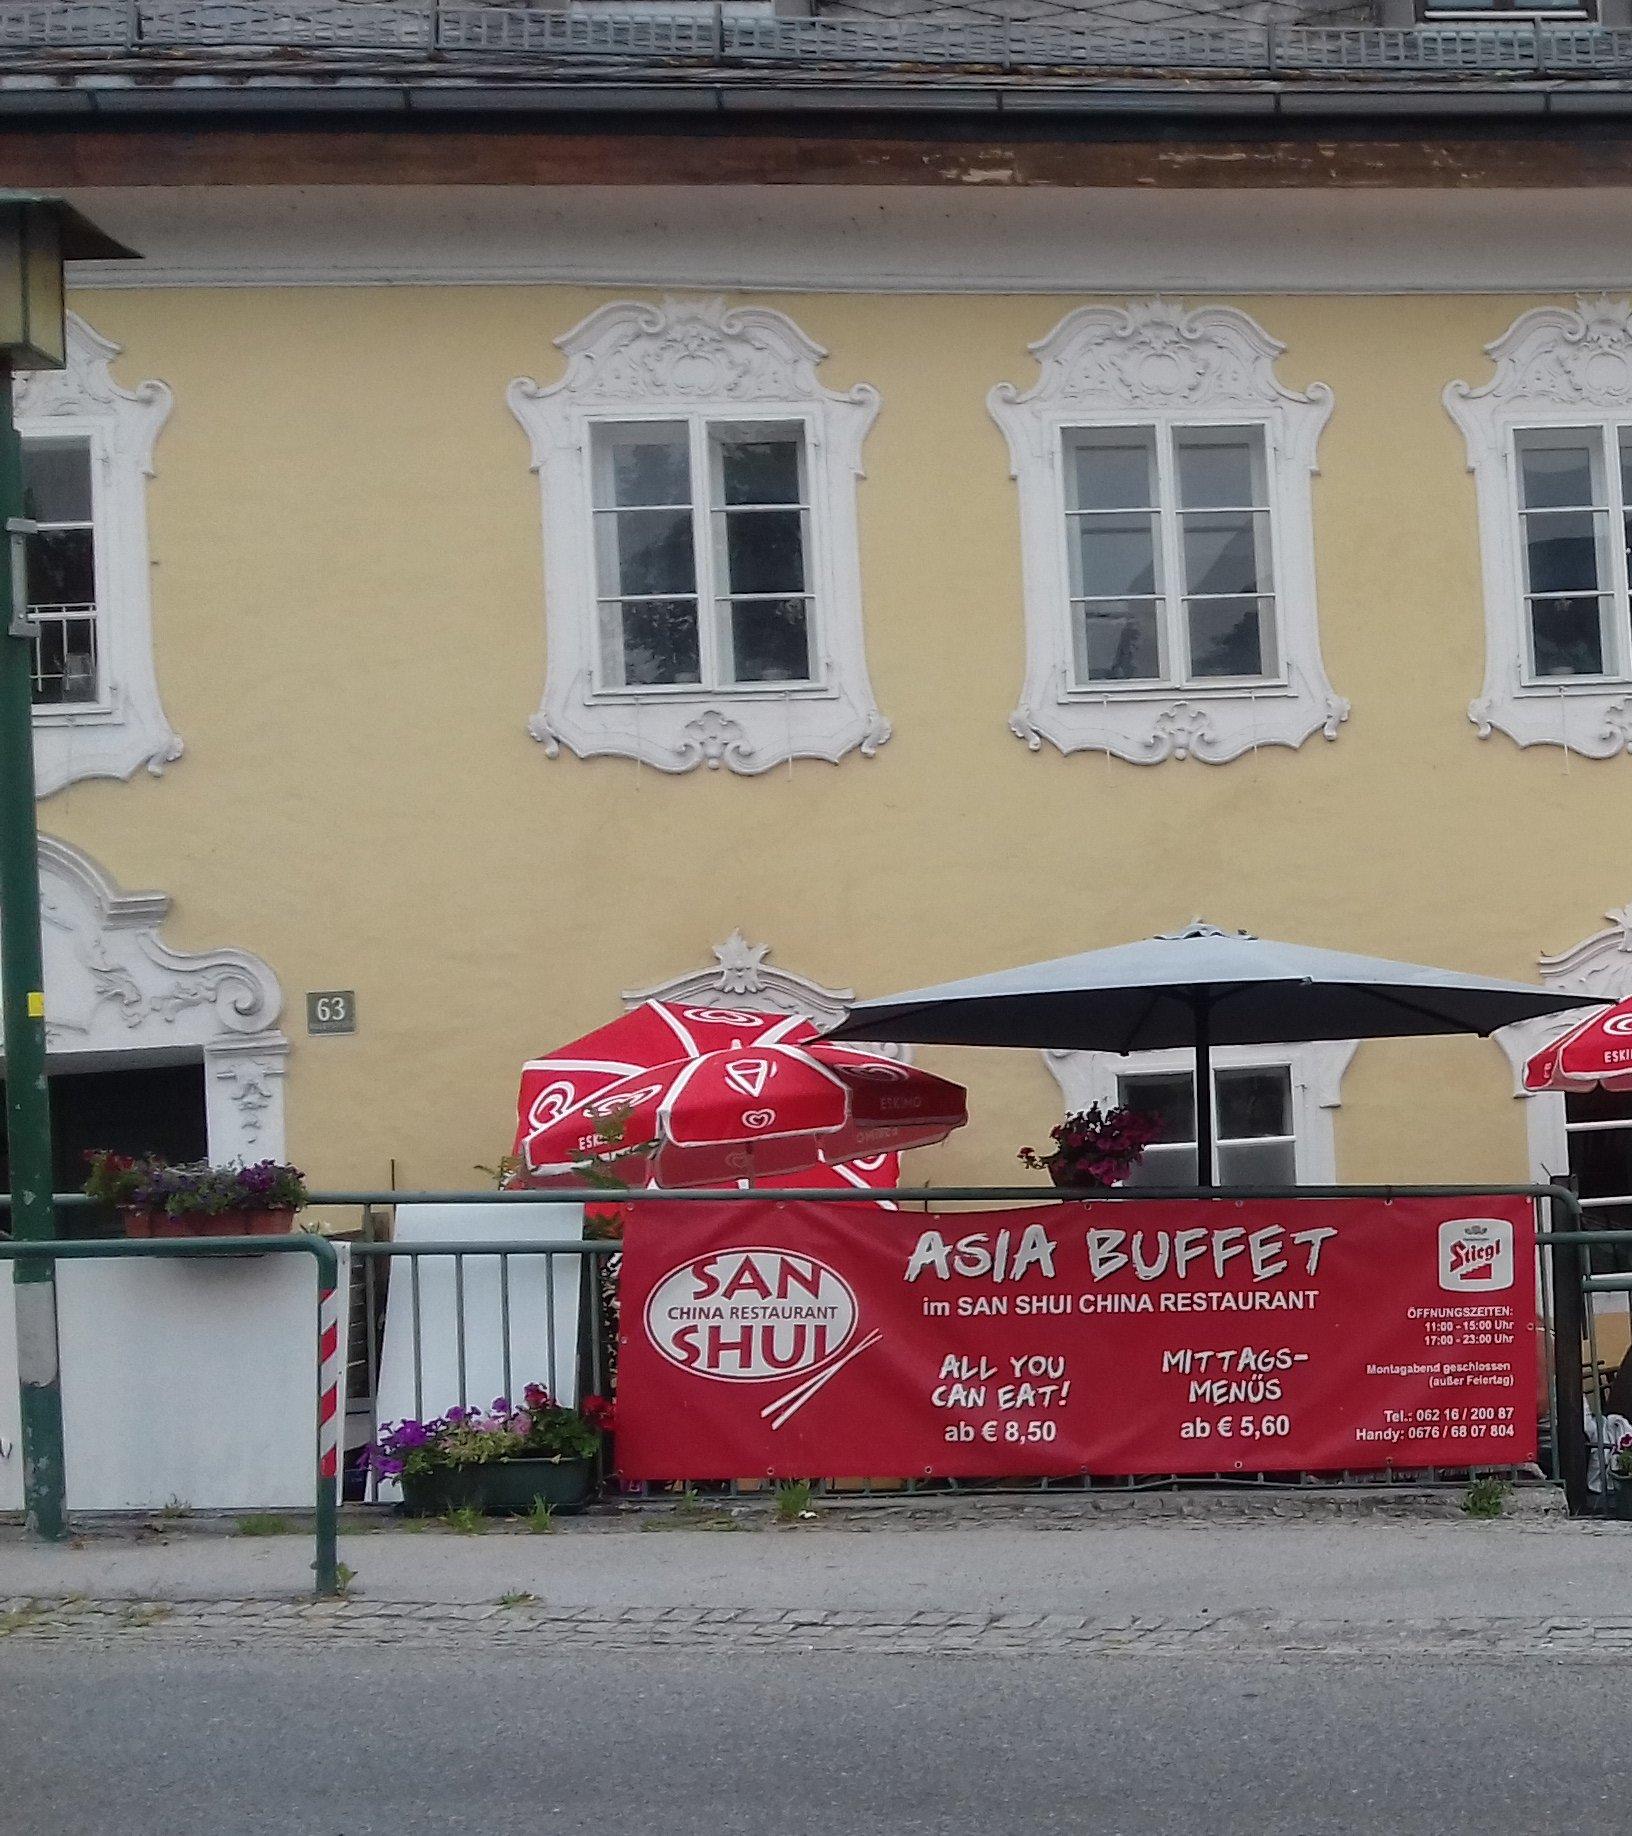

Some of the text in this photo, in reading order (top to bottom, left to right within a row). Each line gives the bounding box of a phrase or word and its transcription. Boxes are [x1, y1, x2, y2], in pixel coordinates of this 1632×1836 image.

[317, 997, 345, 1021] 63
[903, 1223, 1339, 1283] ASIA BUFFET
[1449, 1239, 1501, 1273] Stiegl
[691, 1255, 823, 1300] SAN
[667, 1306, 839, 1320] CHINA RESTAURANT
[922, 1290, 1320, 1316] im SAN SHUI CHINA RESTAURANT
[1407, 1305, 1514, 1319] ÖFFNUNGSZEITEN:
[1424, 1321, 1453, 1332] 11:00
[1463, 1321, 1492, 1331] 15:00
[1494, 1320, 1514, 1330] Uhr
[671, 1323, 829, 1370] SHUI
[1424, 1335, 1453, 1345] 17:00
[1463, 1334, 1492, 1344] 23:00
[1494, 1334, 1514, 1344] Uhr
[939, 1353, 1065, 1381] ALL YOU
[1161, 1346, 1309, 1374] MITTAGS-
[1366, 1361, 1511, 1376] Montagabend geschlossen
[1188, 1373, 1282, 1406] MENÜS
[1428, 1375, 1514, 1388] (außer Feiertag)
[931, 1380, 1071, 1411] CAN EAT!
[1180, 1415, 1290, 1440] ab € 5,60
[1383, 1407, 1514, 1423] Tel.: 062 16 / 200 87
[944, 1420, 1057, 1445] ab € 8,50
[1355, 1424, 1514, 1443] Handy: 0676 / 68 07 804
